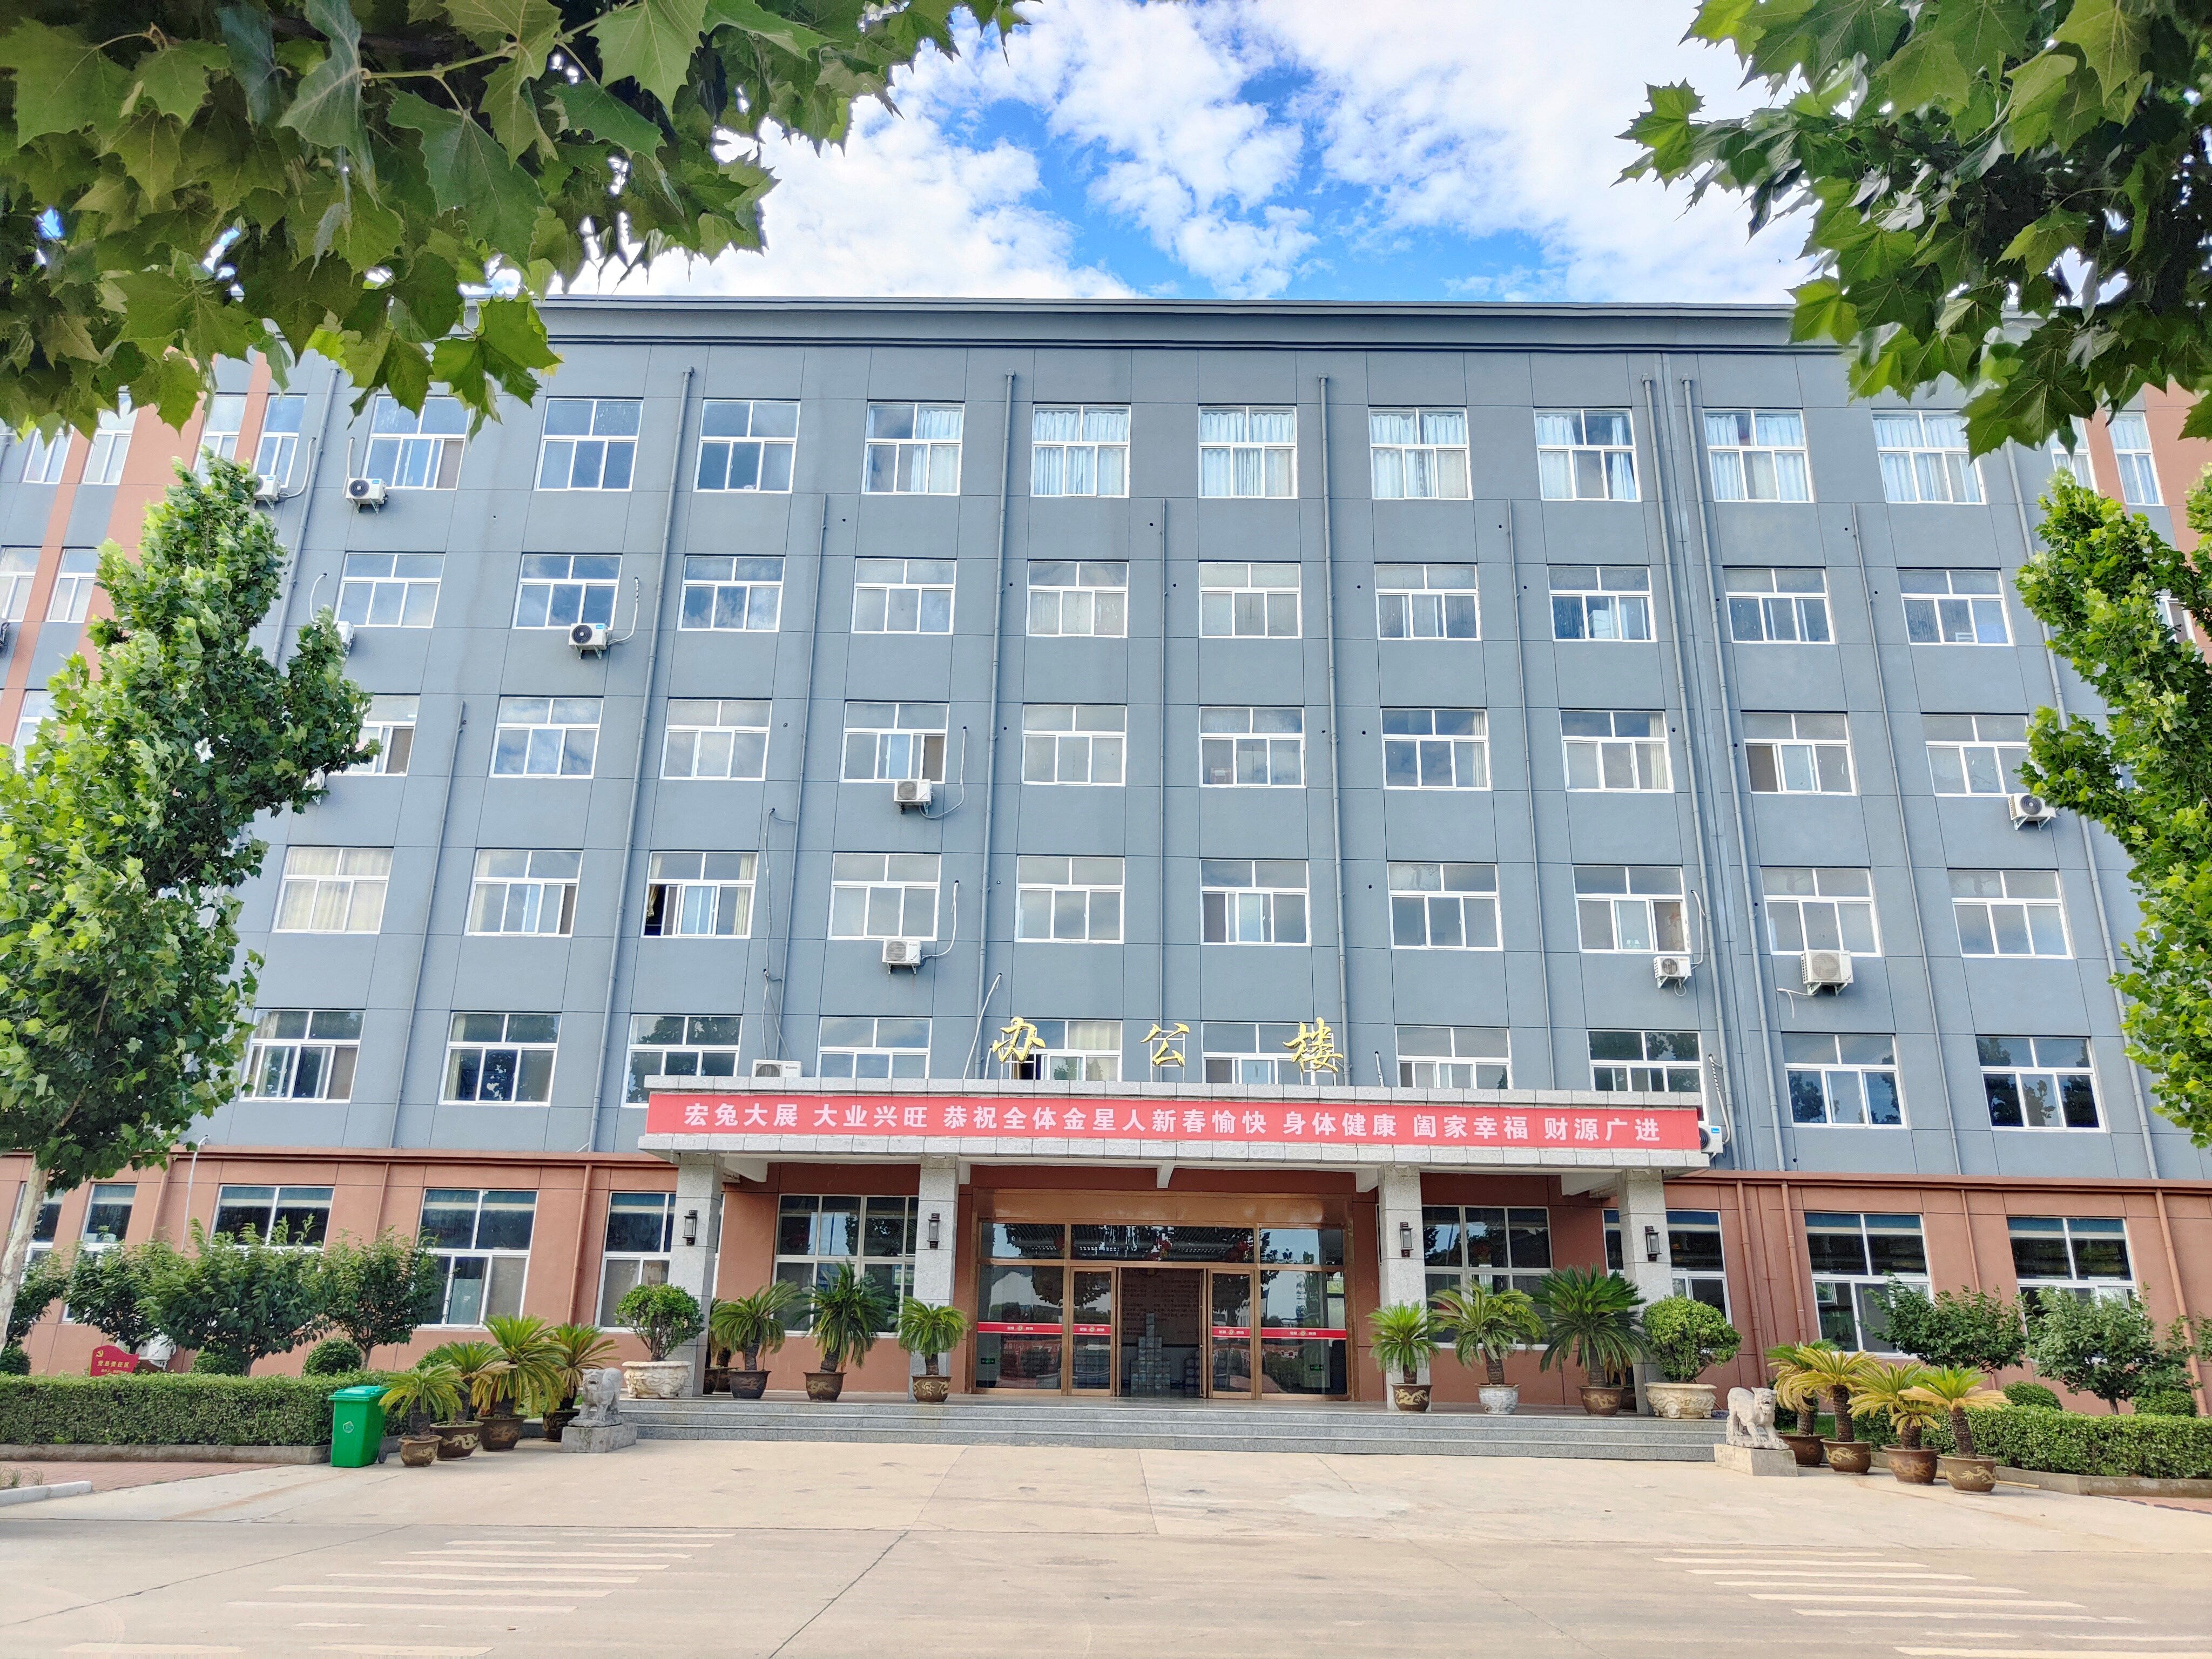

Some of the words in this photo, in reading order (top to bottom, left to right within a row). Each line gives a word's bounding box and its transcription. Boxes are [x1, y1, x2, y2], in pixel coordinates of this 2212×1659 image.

[993, 1016, 1344, 1073] 办公楼
[684, 1103, 798, 1127] 宏兔大展
[813, 1103, 928, 1128] 大业兴旺
[943, 1105, 1266, 1134] 恭祝全体金星人新春愉快
[1283, 1111, 1397, 1137] 身体健康
[1413, 1114, 1528, 1140] 阖家幸福
[1544, 1117, 1661, 1142] 财源广进
